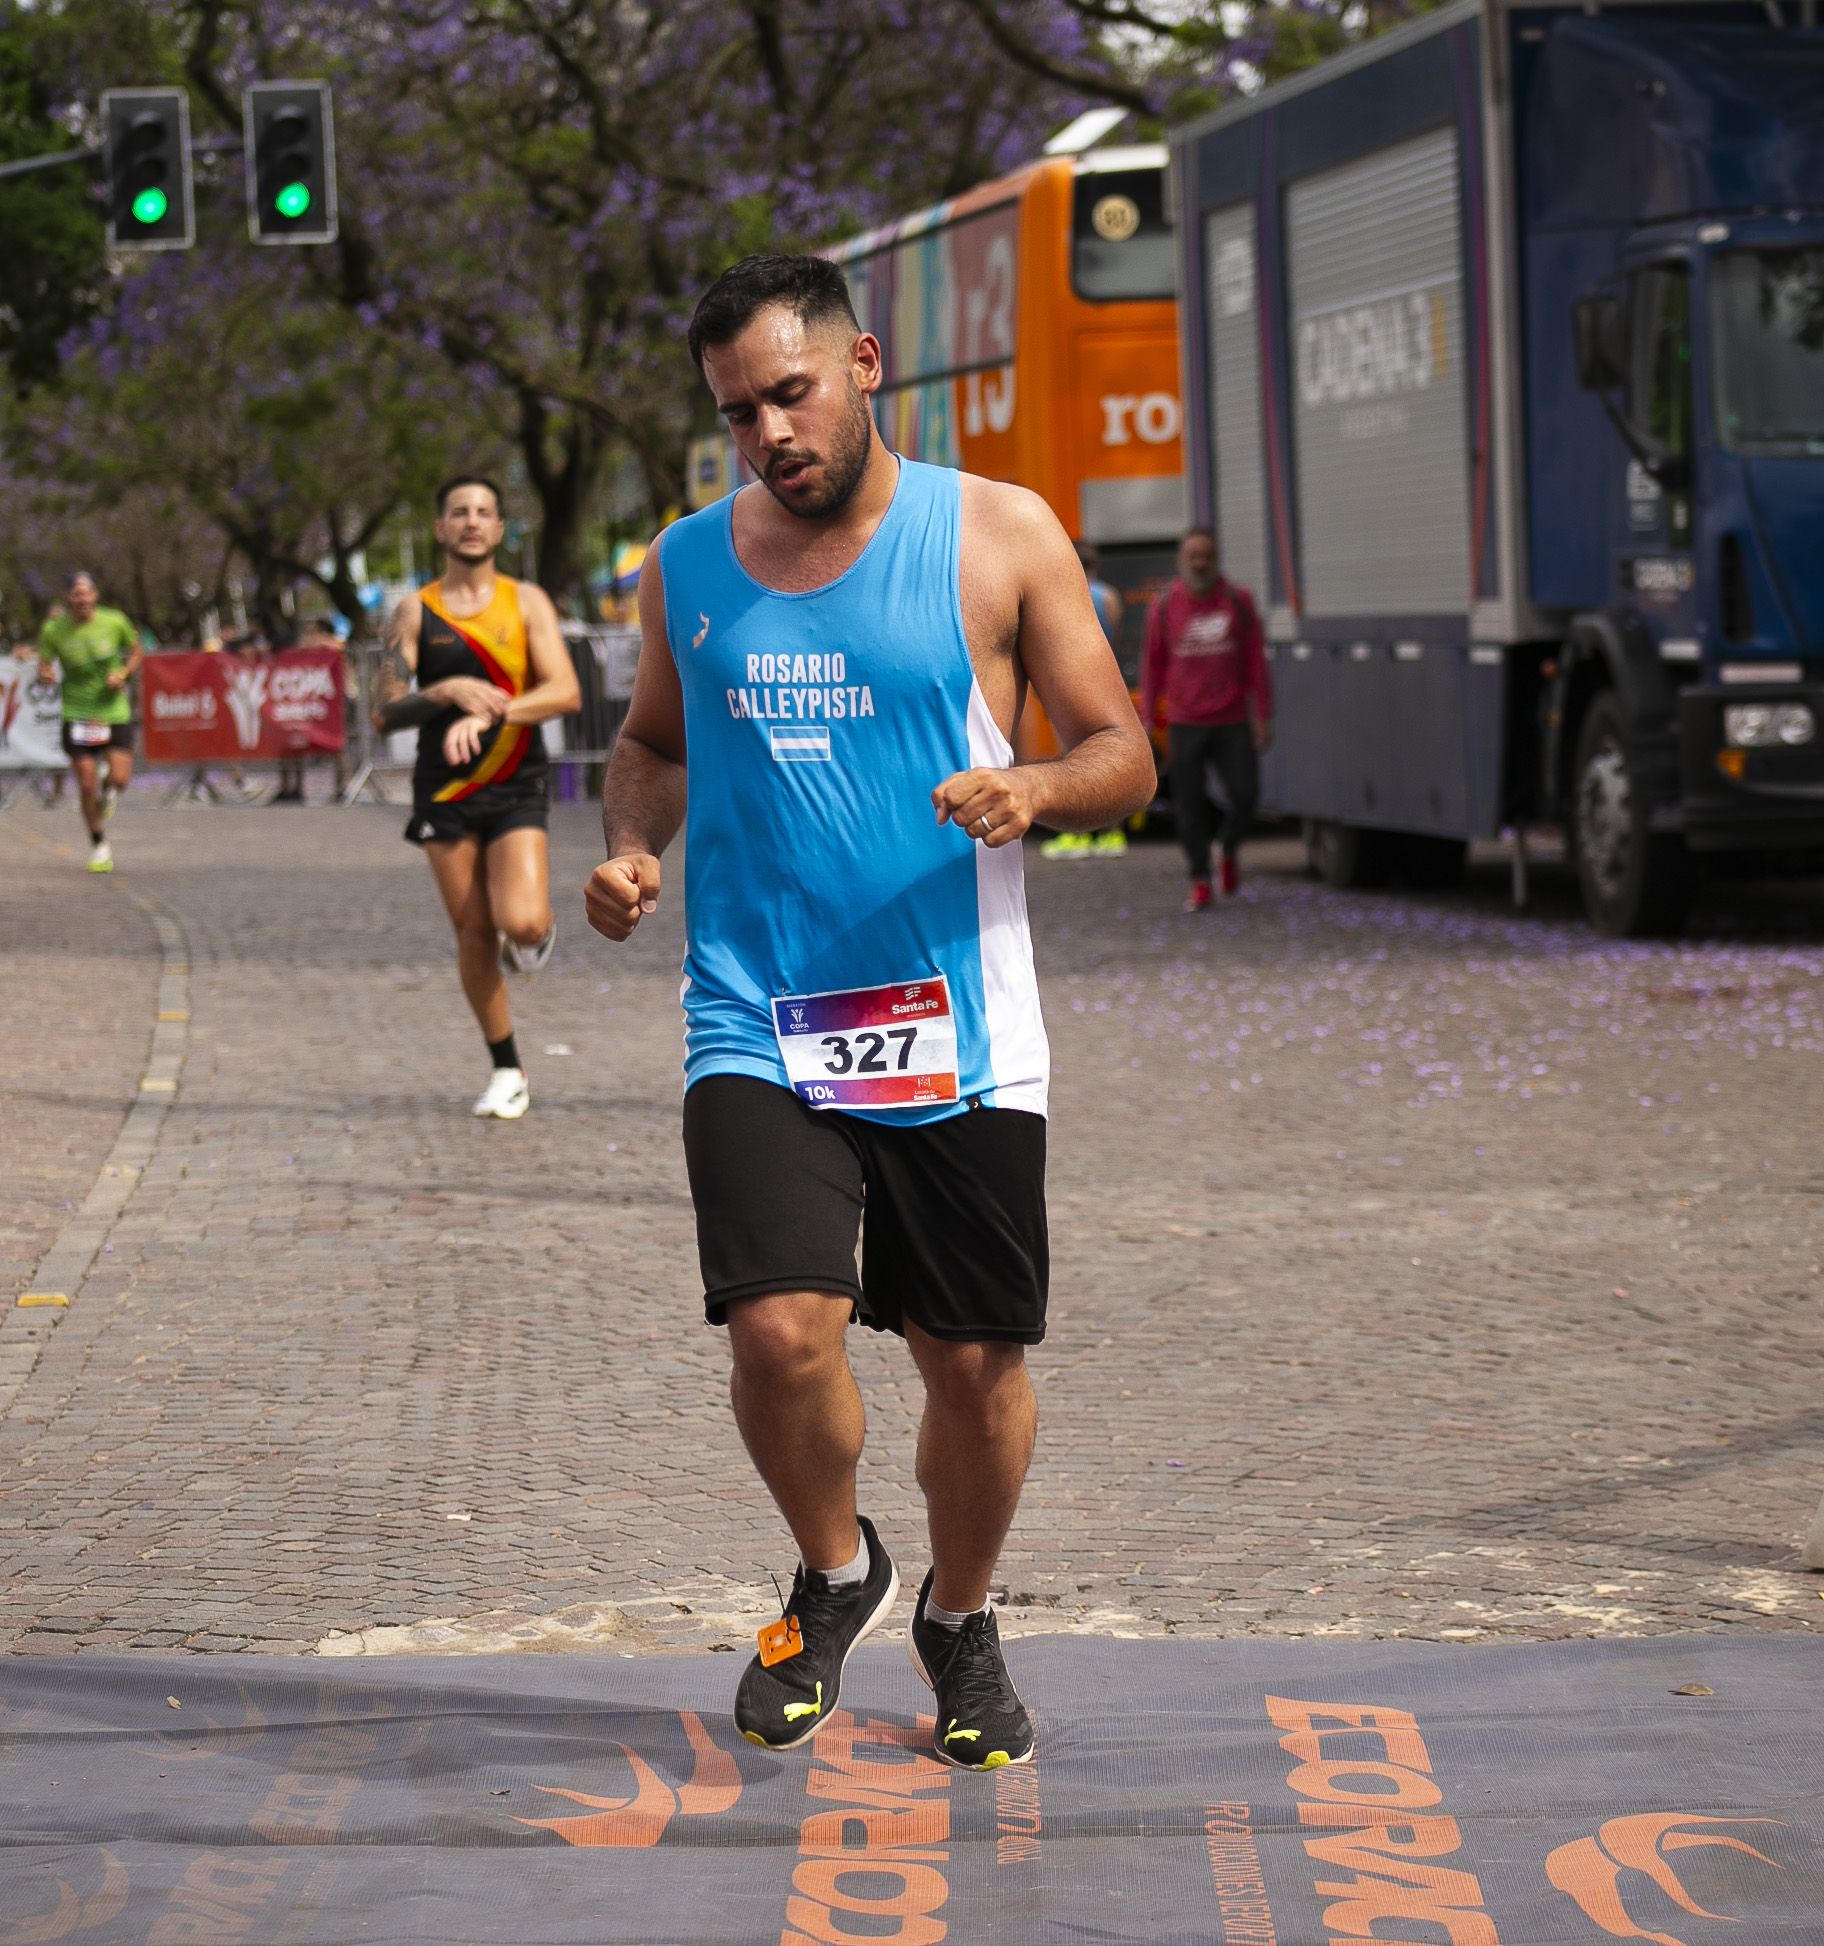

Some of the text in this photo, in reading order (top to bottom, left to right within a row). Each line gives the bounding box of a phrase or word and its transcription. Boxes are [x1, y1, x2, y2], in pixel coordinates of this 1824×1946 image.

[747, 653, 846, 684] ROSARIO
[726, 685, 875, 719] CALLEYPISTA
[891, 999, 939, 1015] Santa Fe
[789, 1022, 810, 1030] COPA
[820, 1026, 918, 1075] 327
[804, 1084, 836, 1101] 10k
[1264, 1694, 1500, 1946] ECORAC
